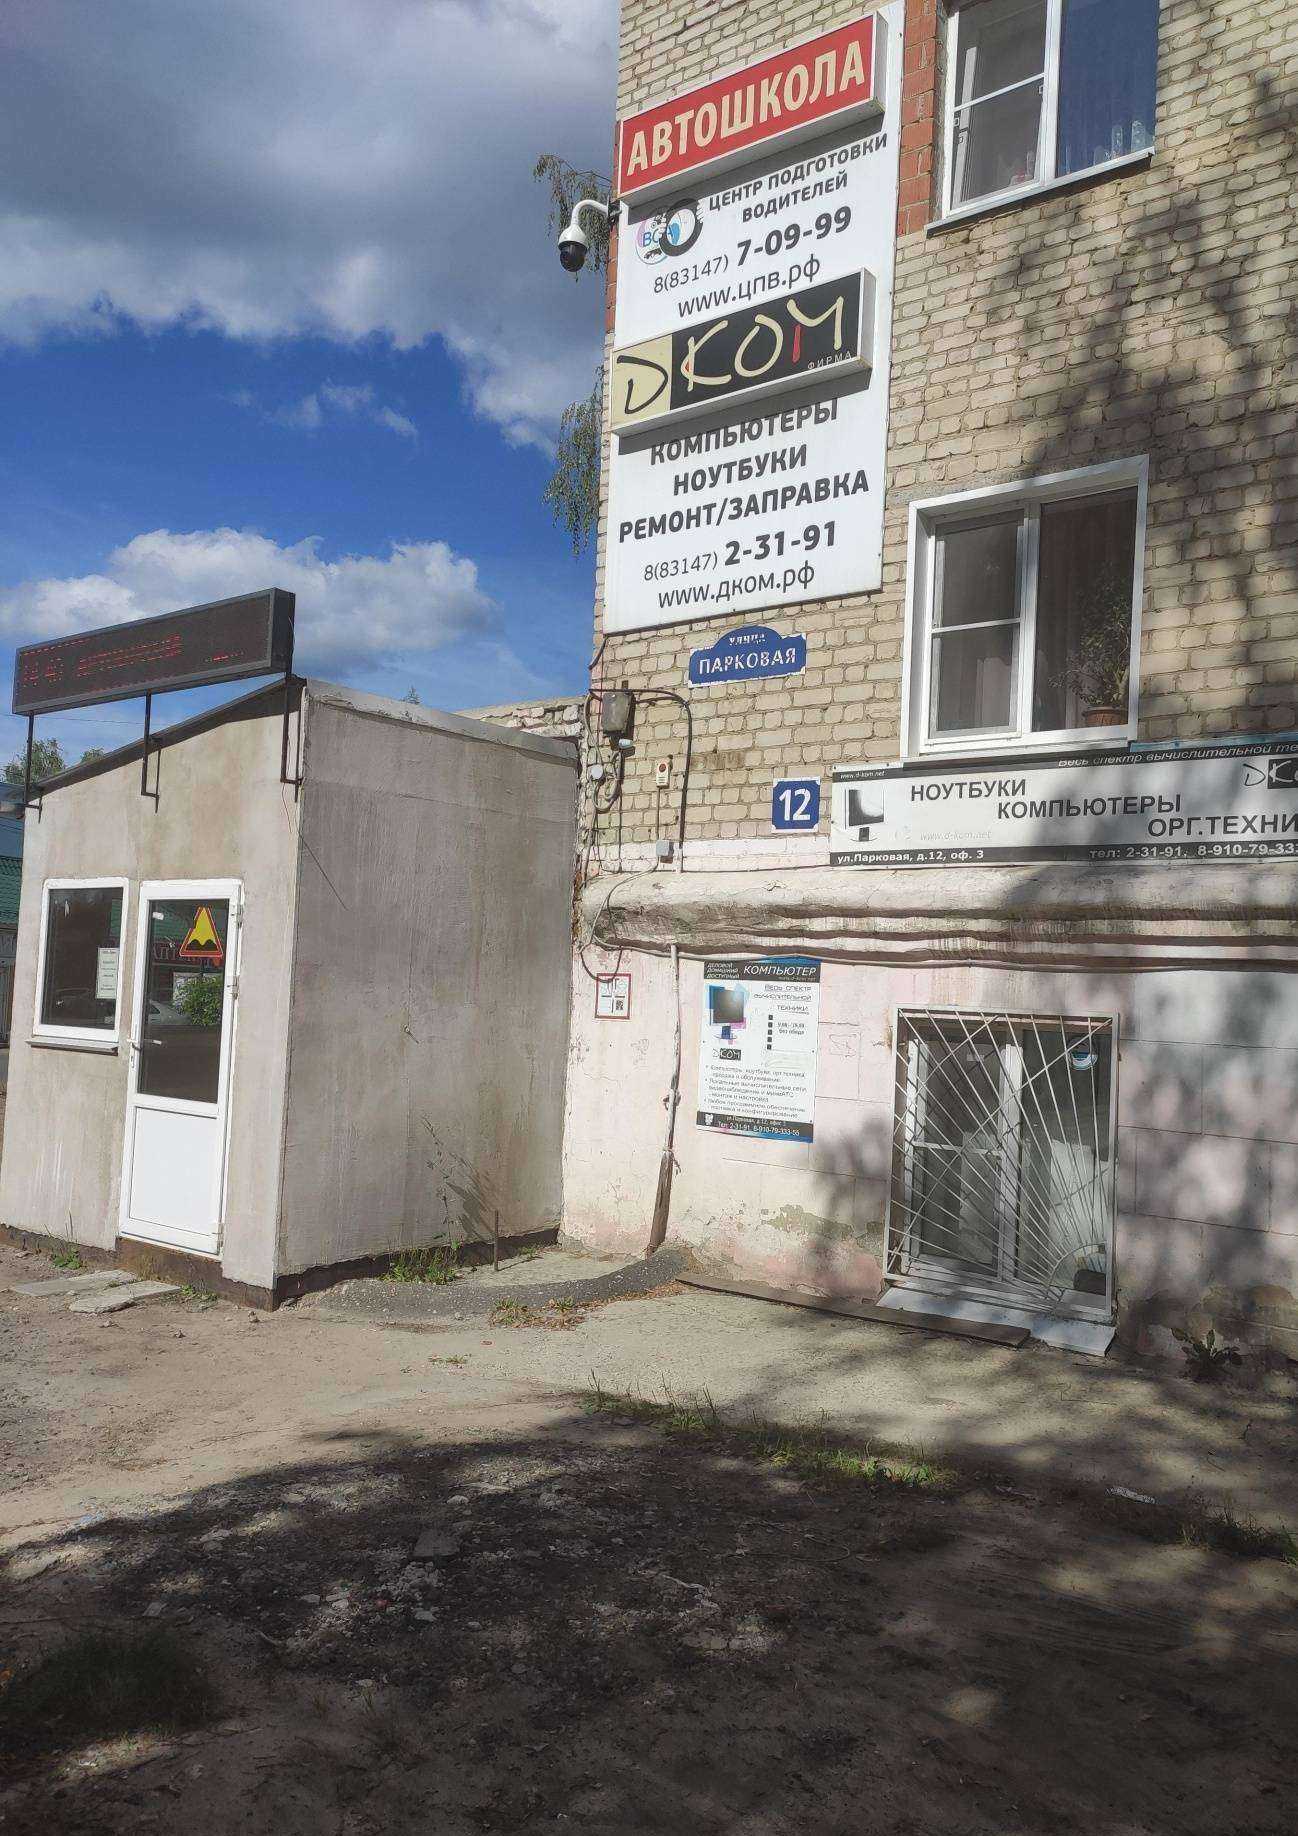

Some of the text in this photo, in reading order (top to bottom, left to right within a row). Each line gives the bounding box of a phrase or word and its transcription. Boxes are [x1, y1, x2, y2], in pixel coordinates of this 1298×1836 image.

[626, 40, 865, 176] АВТОШКОЛА
[709, 133, 888, 211] ЦЕНТР ПОДГОТОВКИ
[742, 169, 848, 222] ВОДИТЕЛЕЙ
[653, 205, 852, 294] 8(83147) 7-09-99
[678, 253, 821, 318] www.цпв.рф
[807, 350, 854, 371] ФИРМА
[650, 397, 839, 466] КОМПЬЮТЕРЫ
[673, 444, 808, 496] НОУТБУКИ
[618, 469, 870, 543] РЕМОНТ/ЗАПРАВКА
[643, 520, 836, 582] 8(83147) 2-31-91
[658, 560, 816, 609] www.дком.рф
[699, 647, 796, 675] ПАРКОВАЯ
[1146, 743, 1272, 761] вычислительной
[779, 788, 811, 822] 12
[911, 778, 1027, 802] НОУТБУКИ
[998, 794, 1181, 820] КОМПЬЮТЕРЫ
[976, 849, 985, 860] 3
[743, 965, 817, 977] КОМПЬЮТЕР
